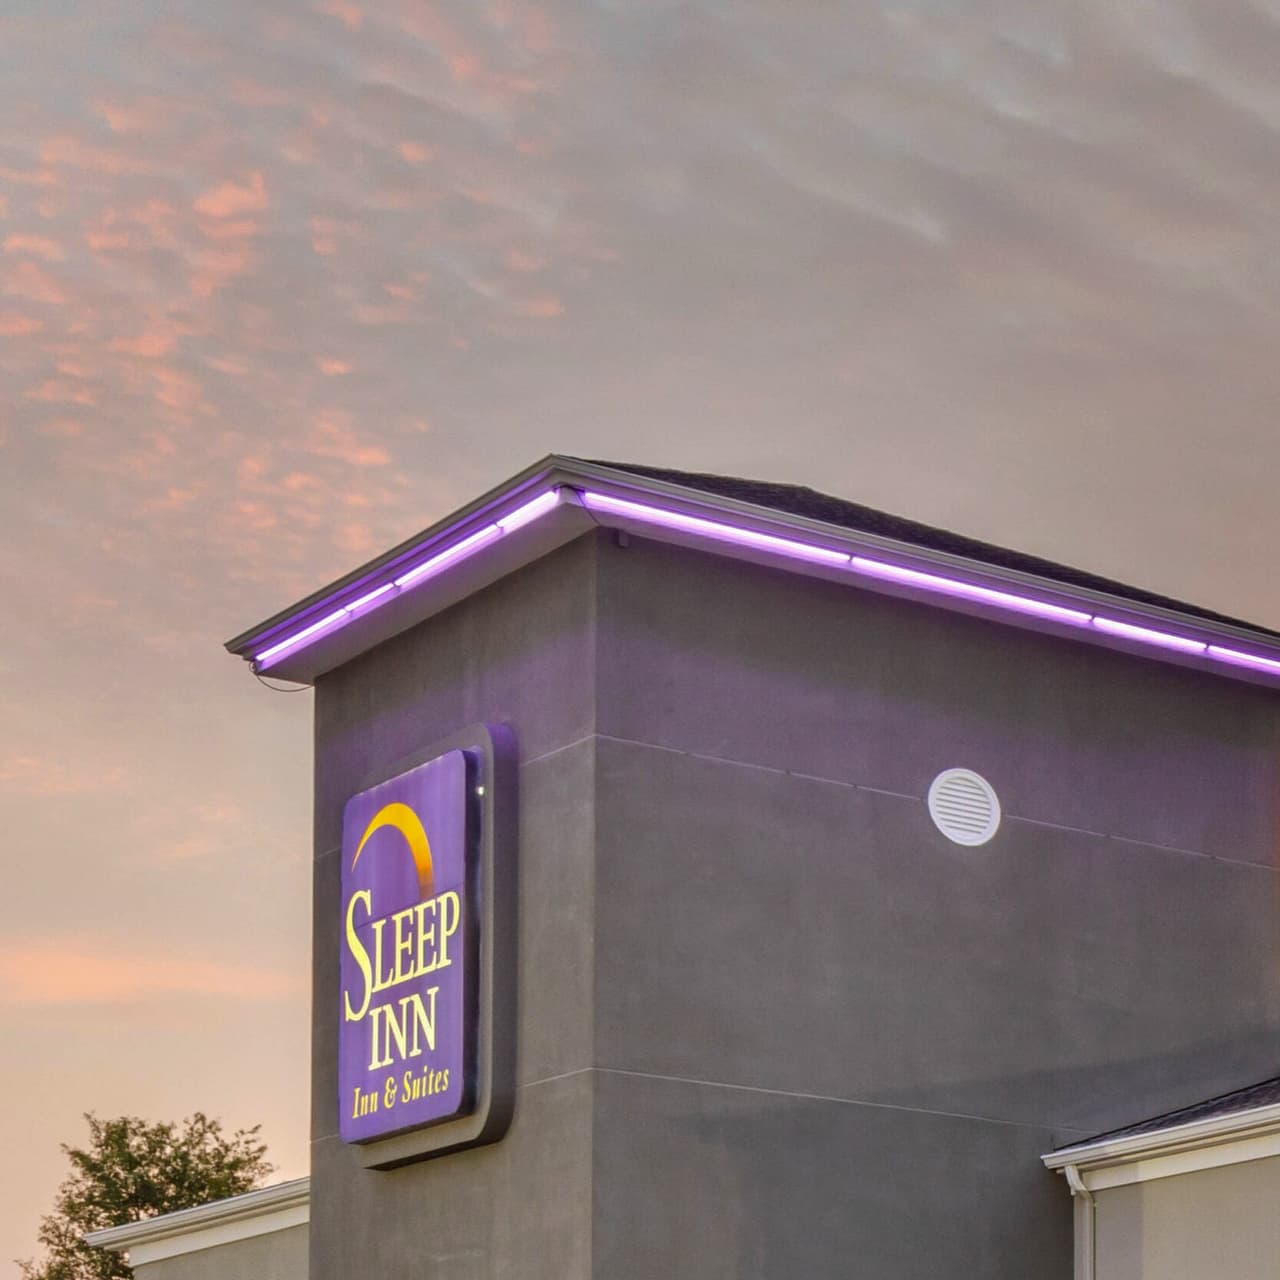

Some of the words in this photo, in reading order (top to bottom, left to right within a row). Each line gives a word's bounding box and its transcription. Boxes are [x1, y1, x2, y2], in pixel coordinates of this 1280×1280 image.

[345, 889, 460, 1022] SLEEP
[368, 986, 439, 1071] INN
[352, 1086, 378, 1119] Inn
[384, 1076, 398, 1109] &
[402, 1065, 449, 1104] Suites
